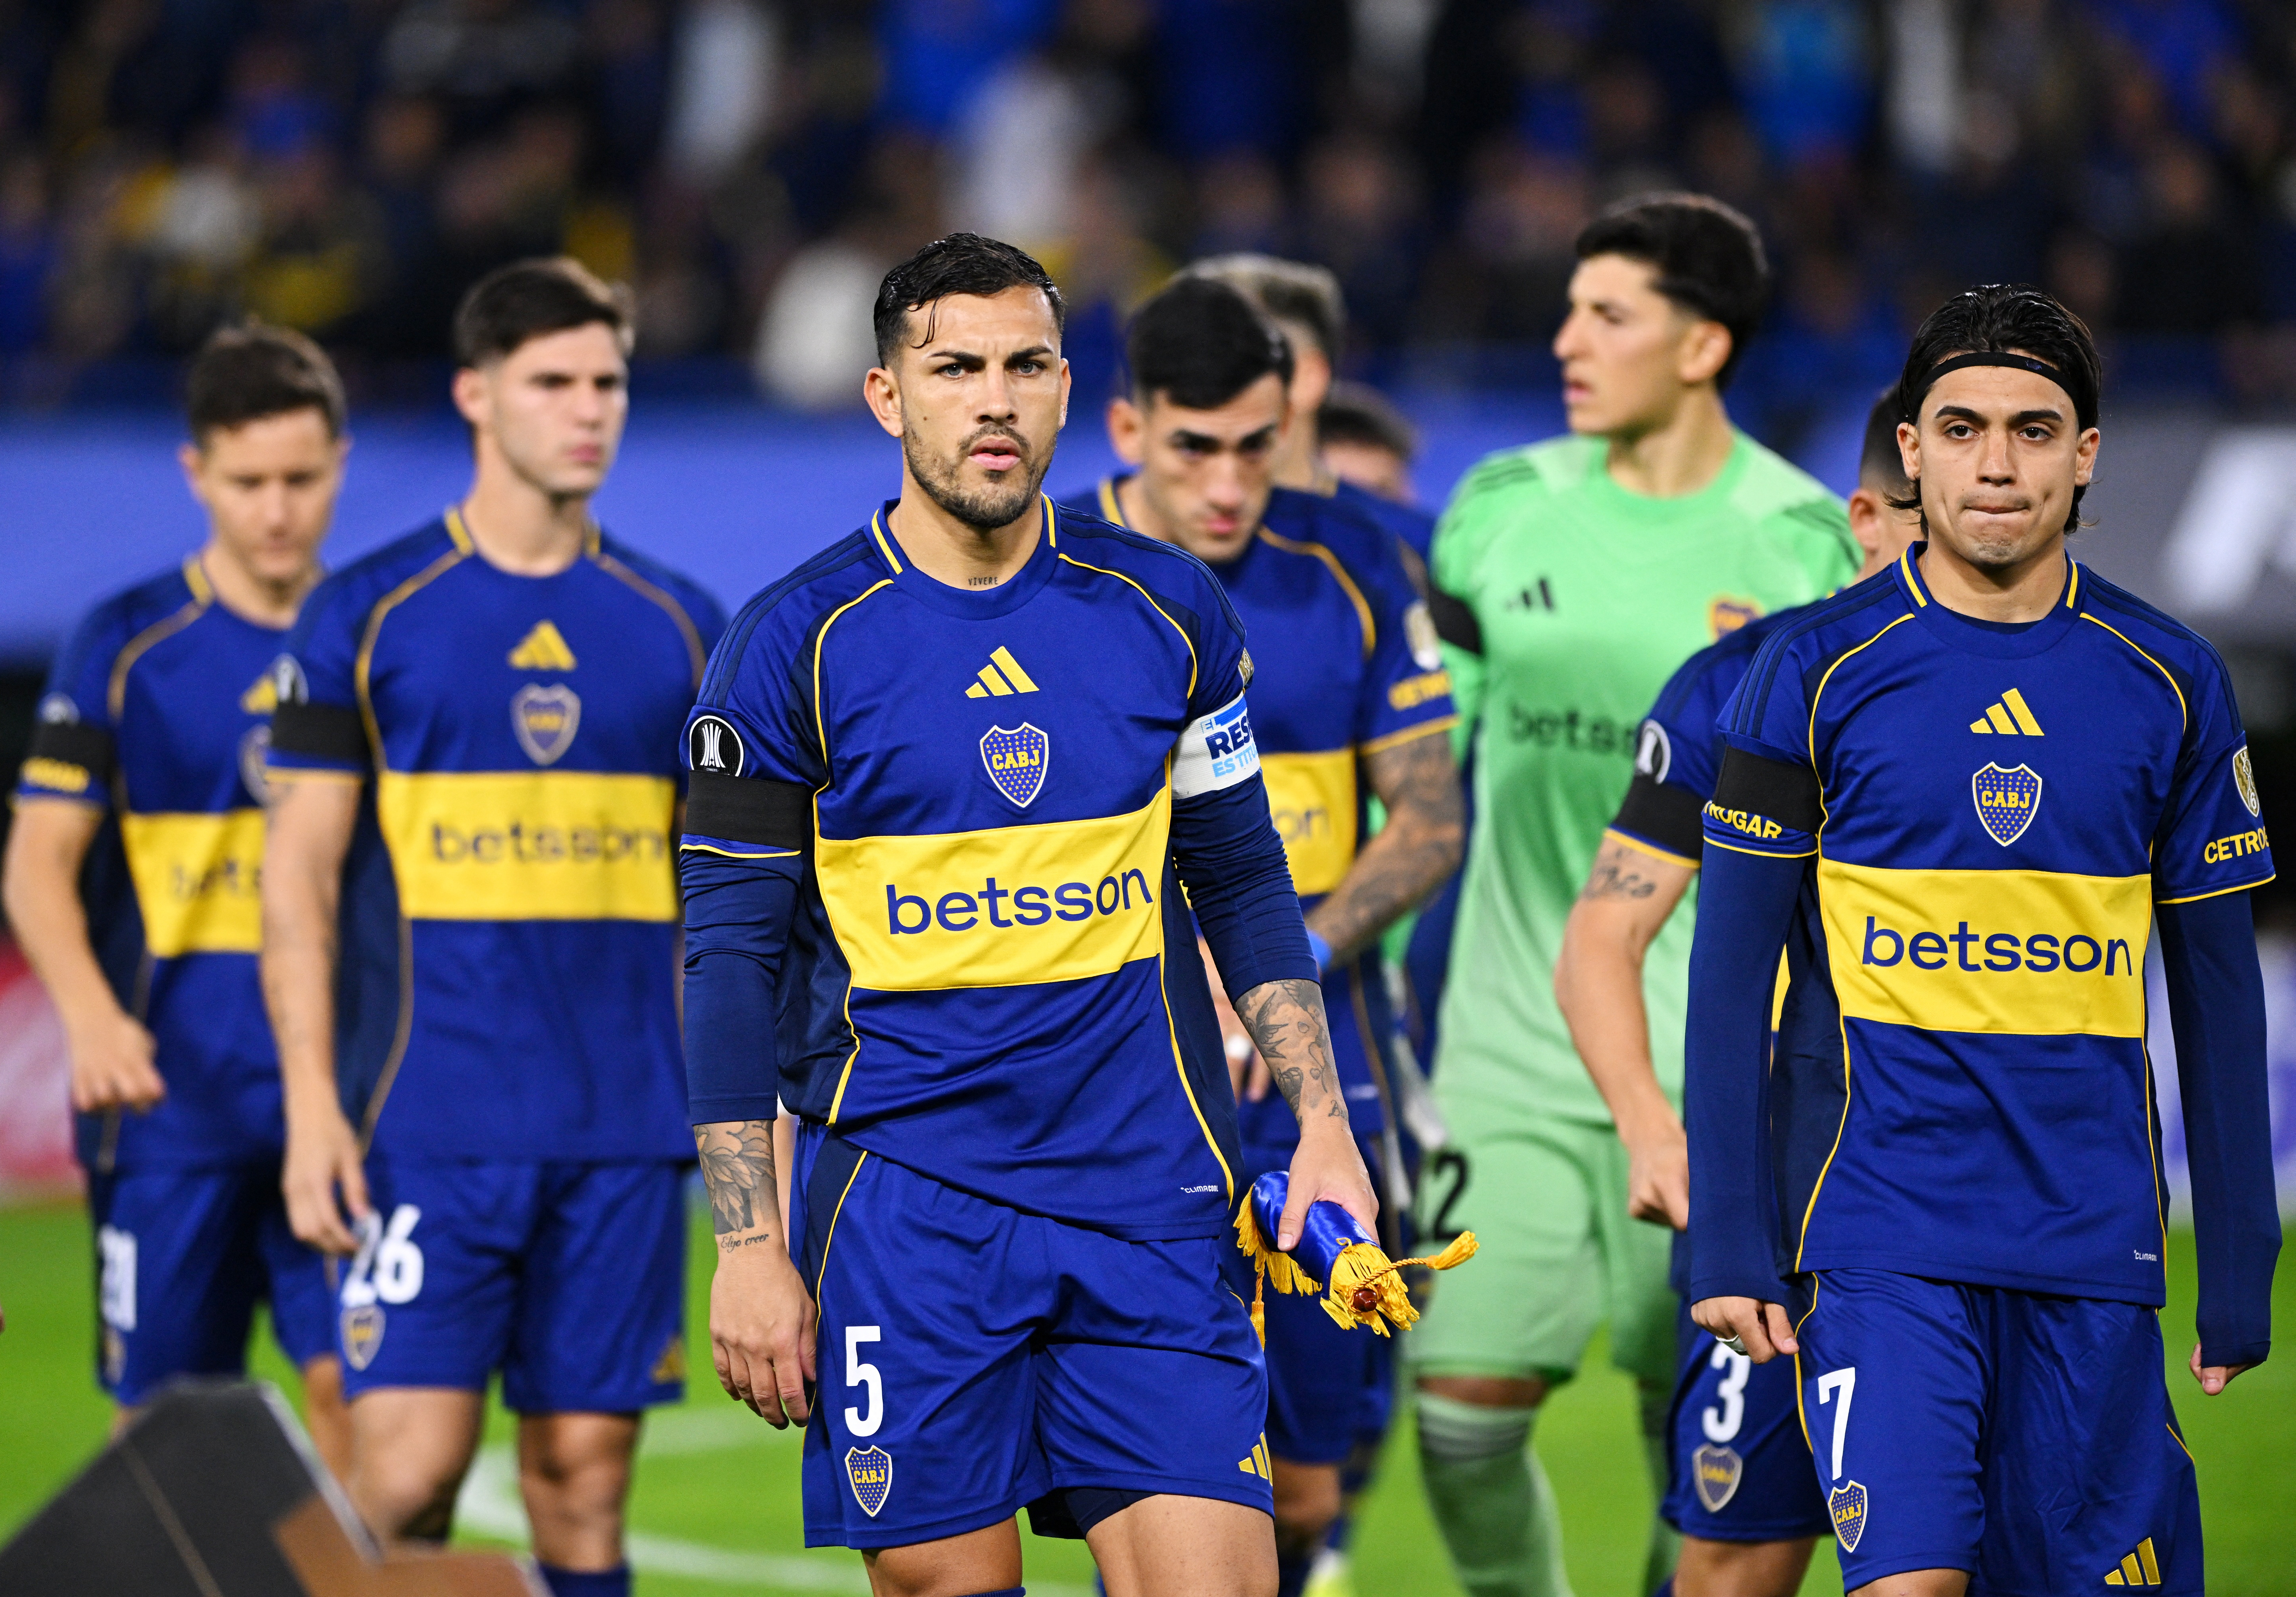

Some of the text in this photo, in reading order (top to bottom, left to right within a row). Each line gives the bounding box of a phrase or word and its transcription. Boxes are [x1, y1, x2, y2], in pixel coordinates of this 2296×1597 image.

[968, 577, 998, 586] VIVERE
[992, 749, 1040, 771] CABJ
[1212, 758, 1236, 777] ES
[1981, 791, 2031, 808] CABJ
[431, 818, 665, 864] betsson
[886, 868, 1153, 935] betsson
[1862, 916, 2132, 976] betsson
[845, 1326, 883, 1437] 5
[1702, 1340, 1751, 1443] 3
[1818, 1367, 1855, 1481] 7
[854, 1469, 885, 1484] CABJ
[1835, 1504, 1862, 1524] CABJ
